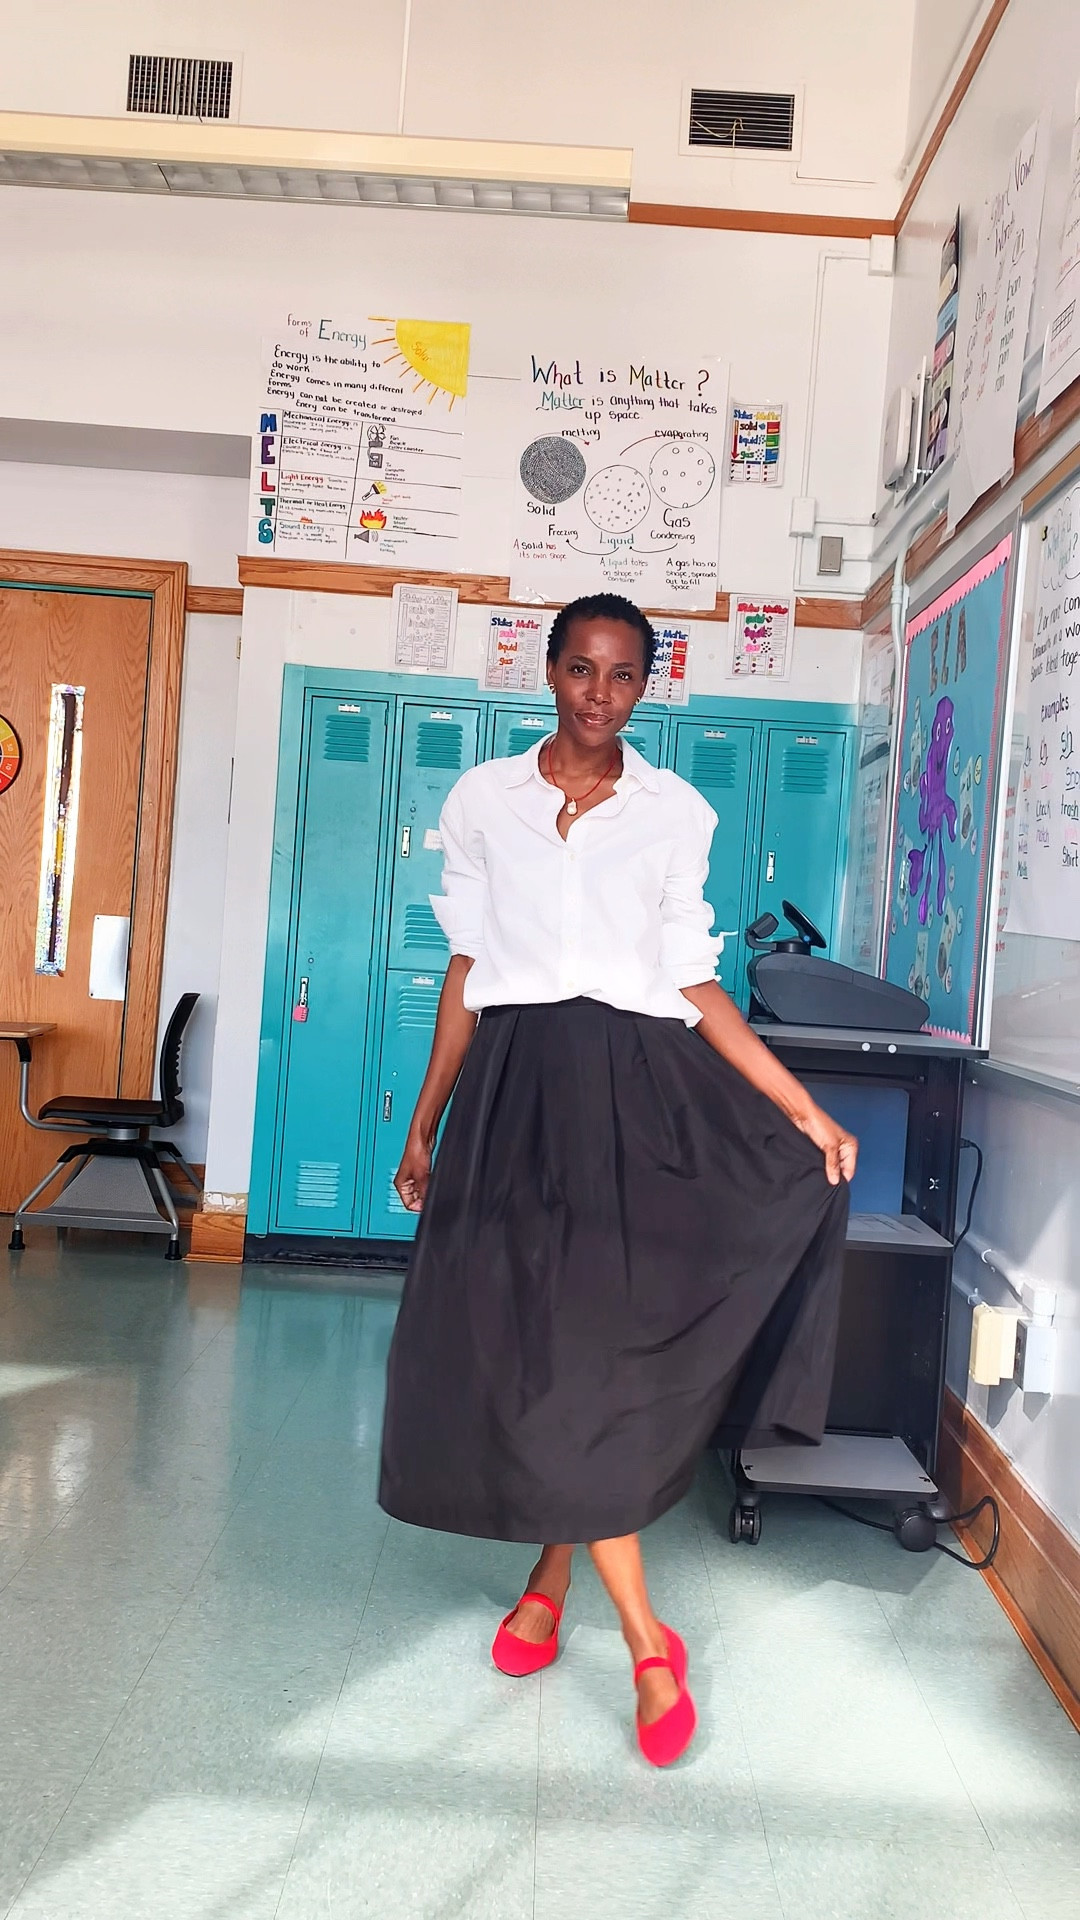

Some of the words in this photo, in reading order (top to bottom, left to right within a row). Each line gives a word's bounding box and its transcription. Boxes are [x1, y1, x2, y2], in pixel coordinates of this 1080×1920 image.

[299, 327, 309, 337] of
[318, 319, 367, 351] Energy
[272, 361, 283, 369] do
[274, 344, 308, 364] Energy
[312, 355, 321, 363] is
[324, 354, 338, 363] the
[340, 358, 367, 373] ability
[531, 355, 584, 389] What
[599, 368, 617, 383] is
[629, 365, 686, 392] Matter
[270, 369, 300, 383] Energy
[344, 383, 367, 393] many
[369, 383, 404, 394] different
[267, 387, 295, 399] Energy
[345, 400, 377, 409] created
[390, 406, 423, 417] destroyed
[541, 391, 586, 410] Matter
[591, 396, 604, 406] is
[609, 395, 654, 411] anything
[658, 396, 680, 409] that
[688, 400, 718, 415] takes
[585, 411, 602, 424] up
[740, 420, 757, 431] solid
[561, 429, 601, 441] melting
[739, 434, 759, 447] liquid
[740, 451, 755, 459] gas
[527, 501, 556, 516] Solid
[663, 508, 691, 528] Gas
[548, 524, 579, 541] Freezing
[650, 530, 696, 544] Condensing
[513, 538, 520, 550] A
[599, 531, 635, 549] Liquid
[600, 557, 606, 567] A
[666, 557, 674, 567] A
[676, 560, 690, 571] gas
[692, 558, 706, 567] has
[498, 642, 518, 653] liquid
[1060, 794, 1079, 817] trash
